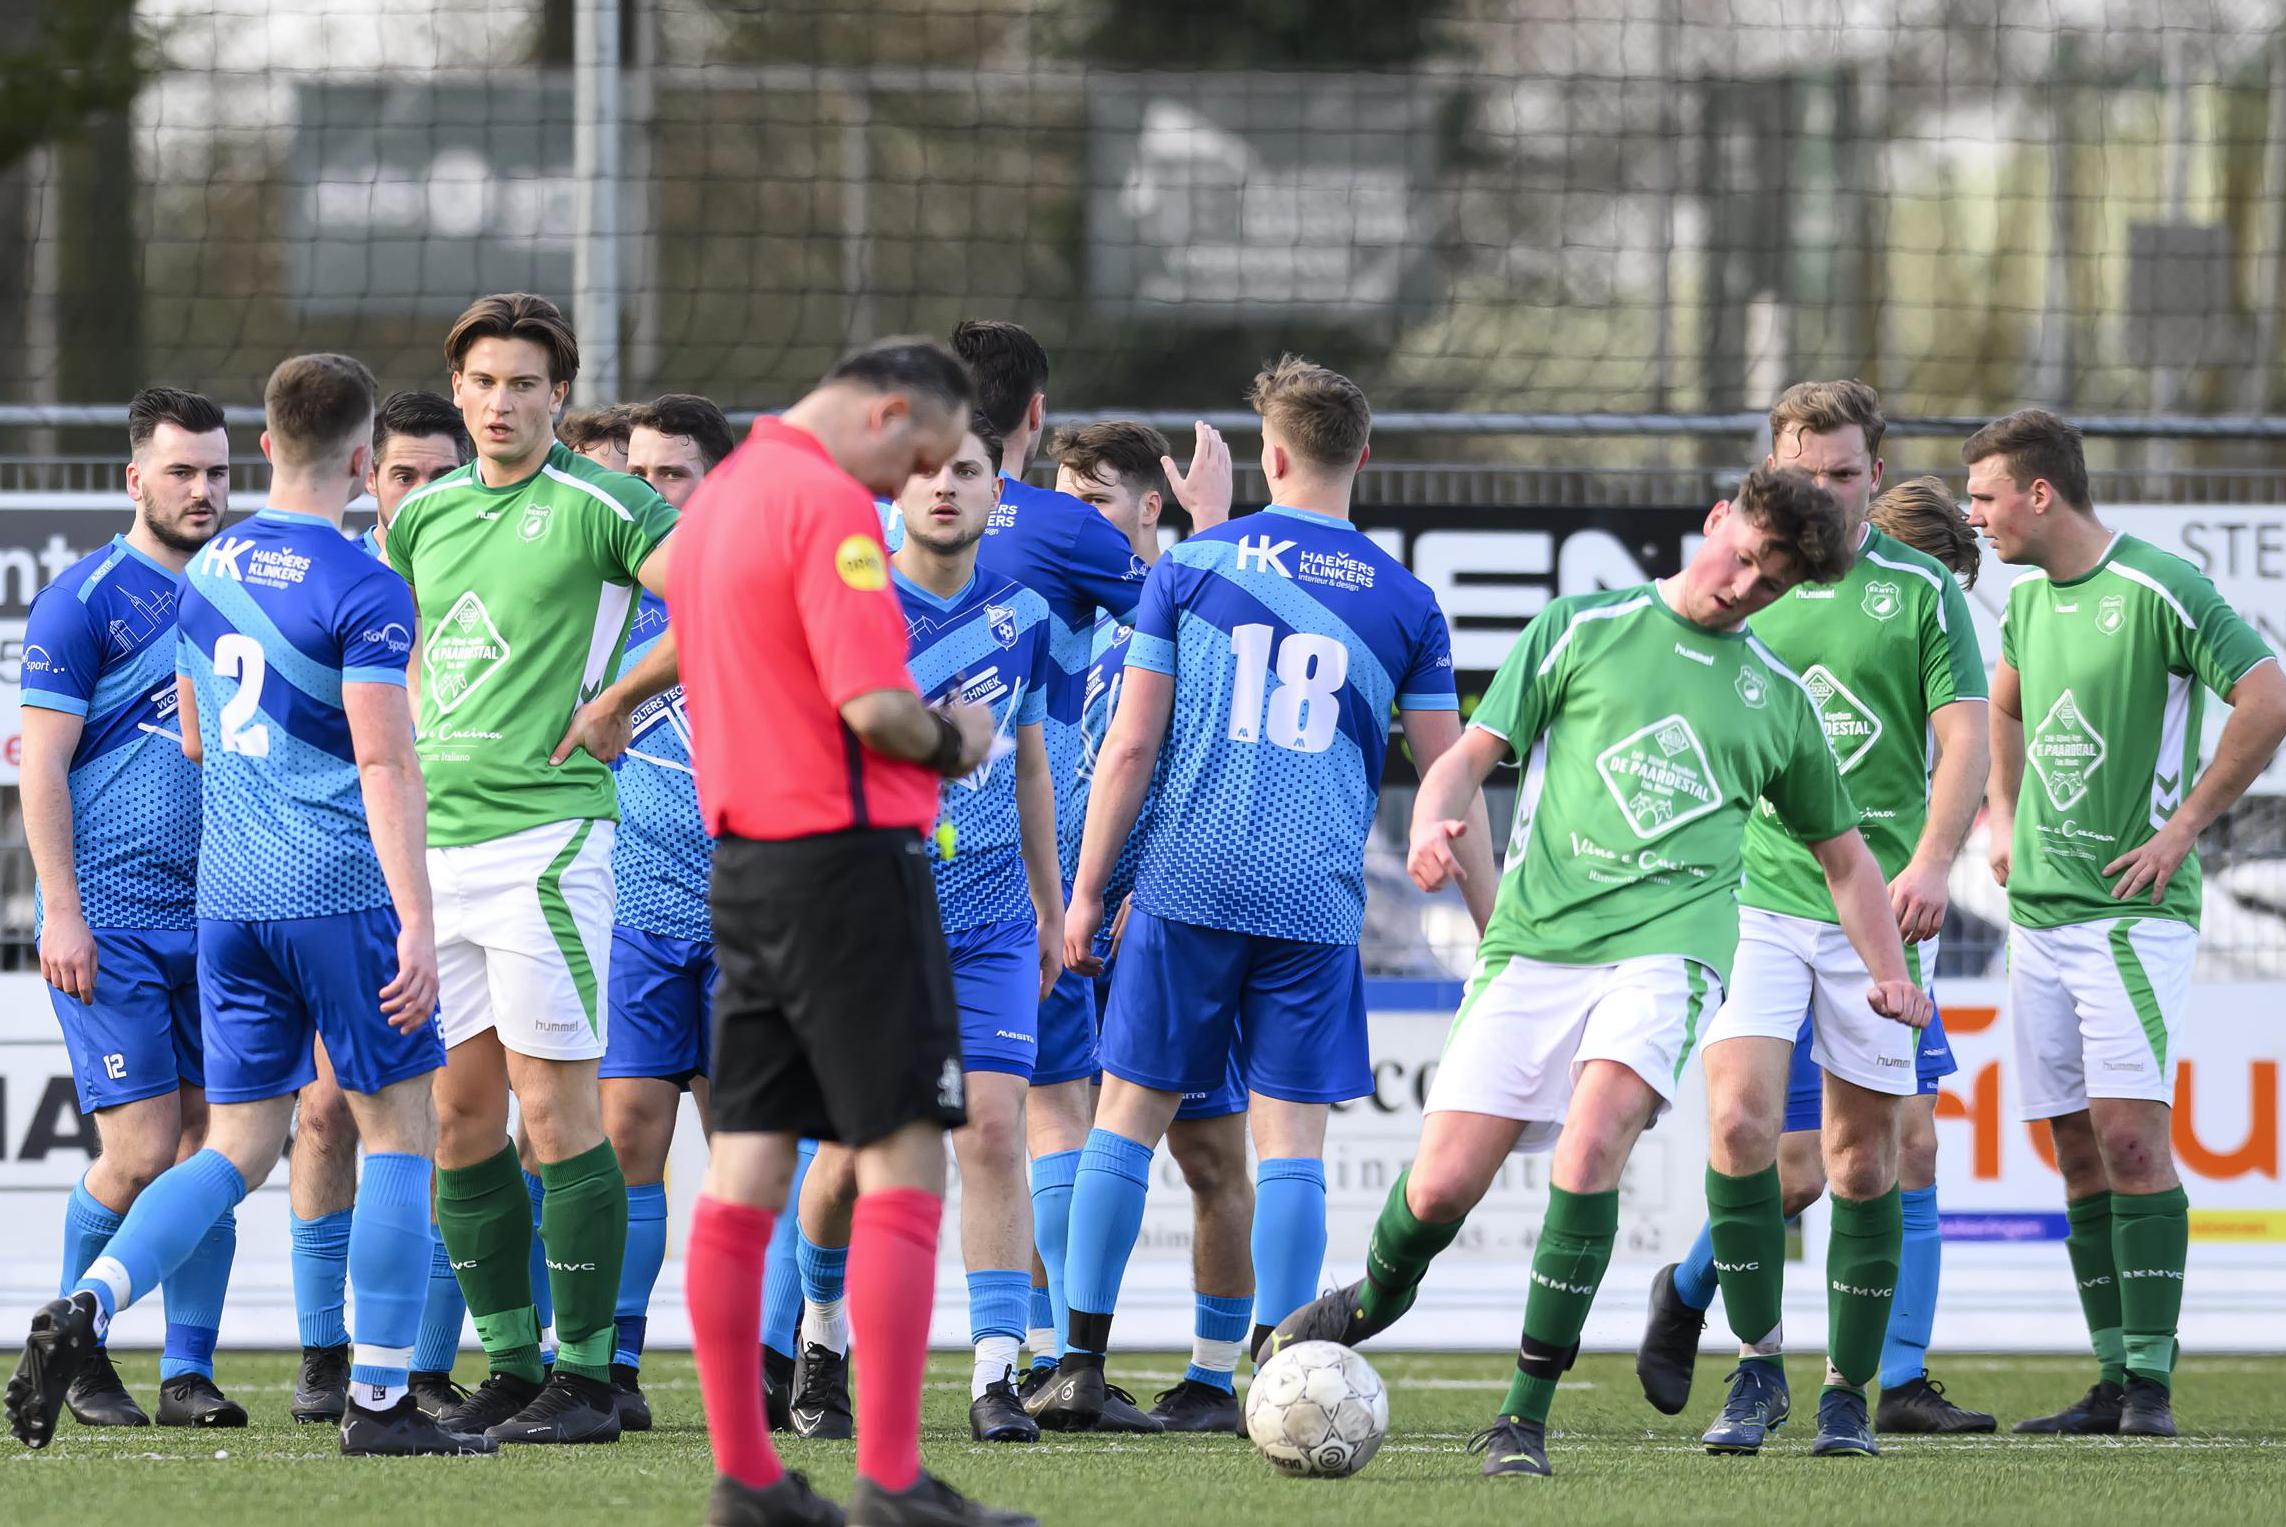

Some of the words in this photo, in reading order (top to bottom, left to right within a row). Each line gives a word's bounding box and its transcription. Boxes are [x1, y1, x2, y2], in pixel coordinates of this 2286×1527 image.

[201, 536, 256, 582] HK
[1236, 533, 1299, 579] HK
[1300, 550, 1376, 578] HAEMERS
[1299, 562, 1374, 588] KLINKERS
[213, 633, 269, 758] 2
[961, 675, 1002, 704] CHNIEK
[1228, 622, 1348, 753] 18
[631, 697, 665, 725] OLTERS
[1824, 720, 1872, 737] DESTAL
[1609, 756, 1629, 774] DE
[1629, 760, 1709, 803] PAARDESTAL
[535, 1019, 579, 1033] hummel
[103, 1052, 128, 1080] 12
[0, 1076, 104, 1162] A
[2078, 1275, 2112, 1290] VC
[2122, 1268, 2185, 1280] RKMVC
[1832, 1279, 1893, 1298] RKMVC
